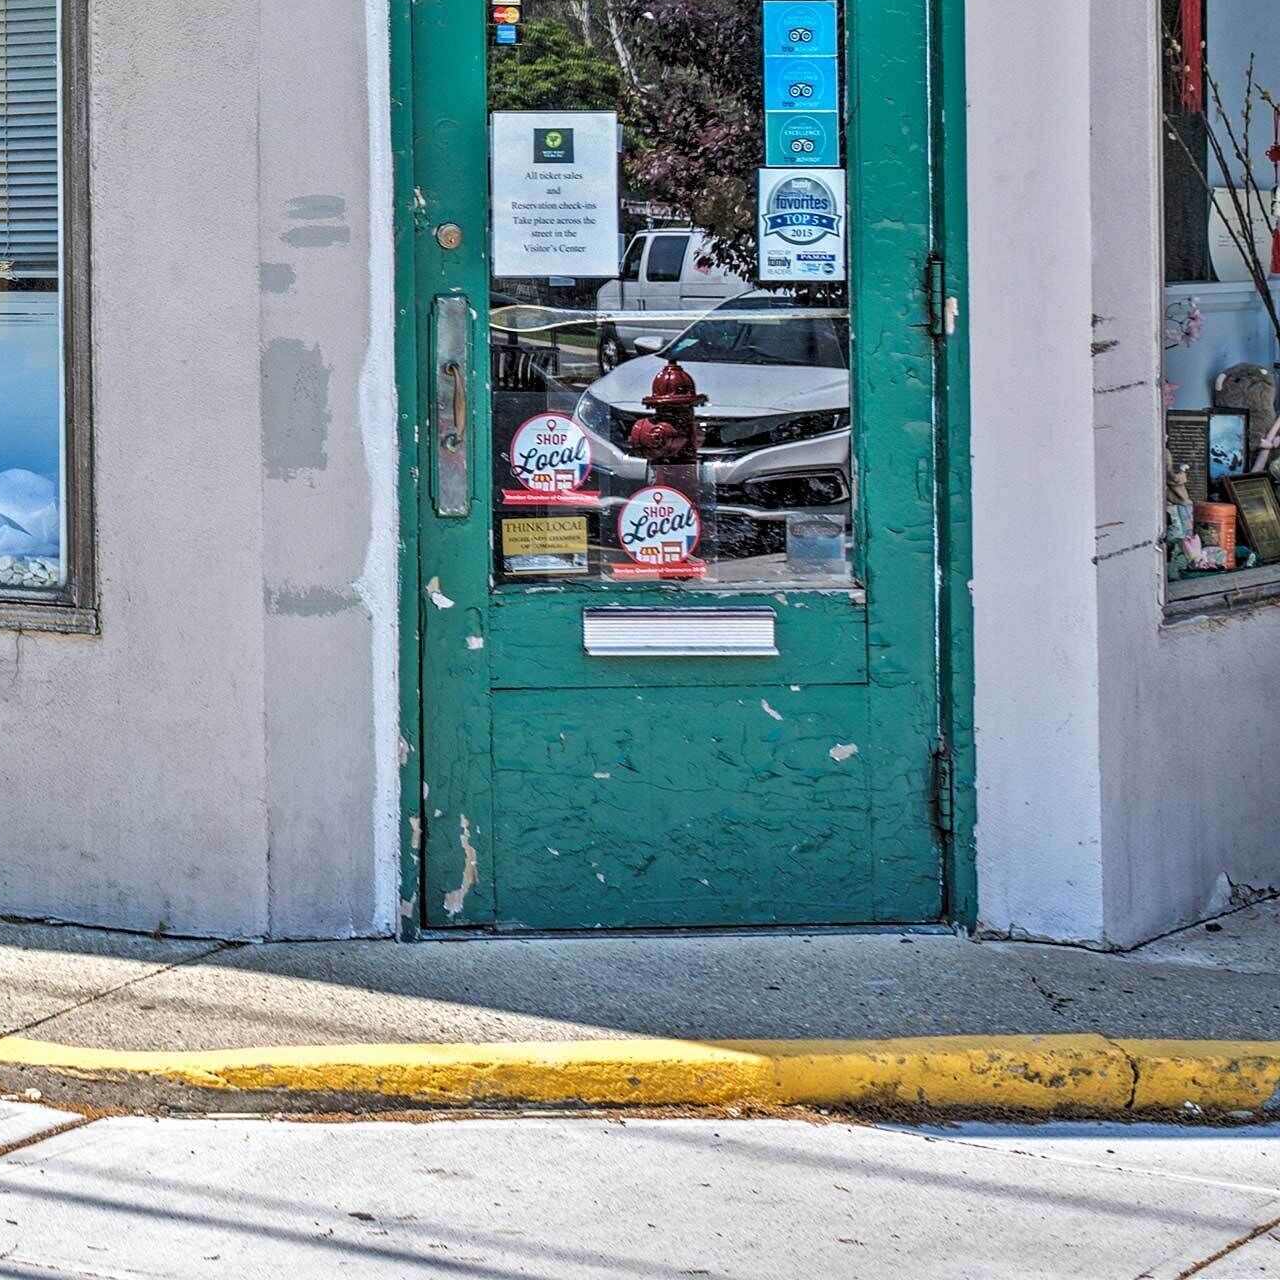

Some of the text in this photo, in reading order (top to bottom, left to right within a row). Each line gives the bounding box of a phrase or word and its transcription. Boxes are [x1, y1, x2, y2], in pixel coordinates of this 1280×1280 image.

[525, 172, 583, 180] All ticket sales
[546, 187, 561, 195] and
[511, 202, 597, 210] Reservation check-ins
[776, 195, 828, 210] favorites
[512, 217, 532, 225] Take
[534, 217, 555, 226] place
[584, 217, 596, 225] the
[784, 214, 819, 225] TOP 5
[531, 230, 577, 238] street in the
[791, 229, 813, 237] 2015
[559, 245, 586, 253] Center
[536, 434, 568, 445] SHOP
[511, 437, 586, 477] Local
[643, 506, 674, 518] SHOP
[505, 520, 583, 533] THINK LOCAL
[622, 508, 695, 545] Local
